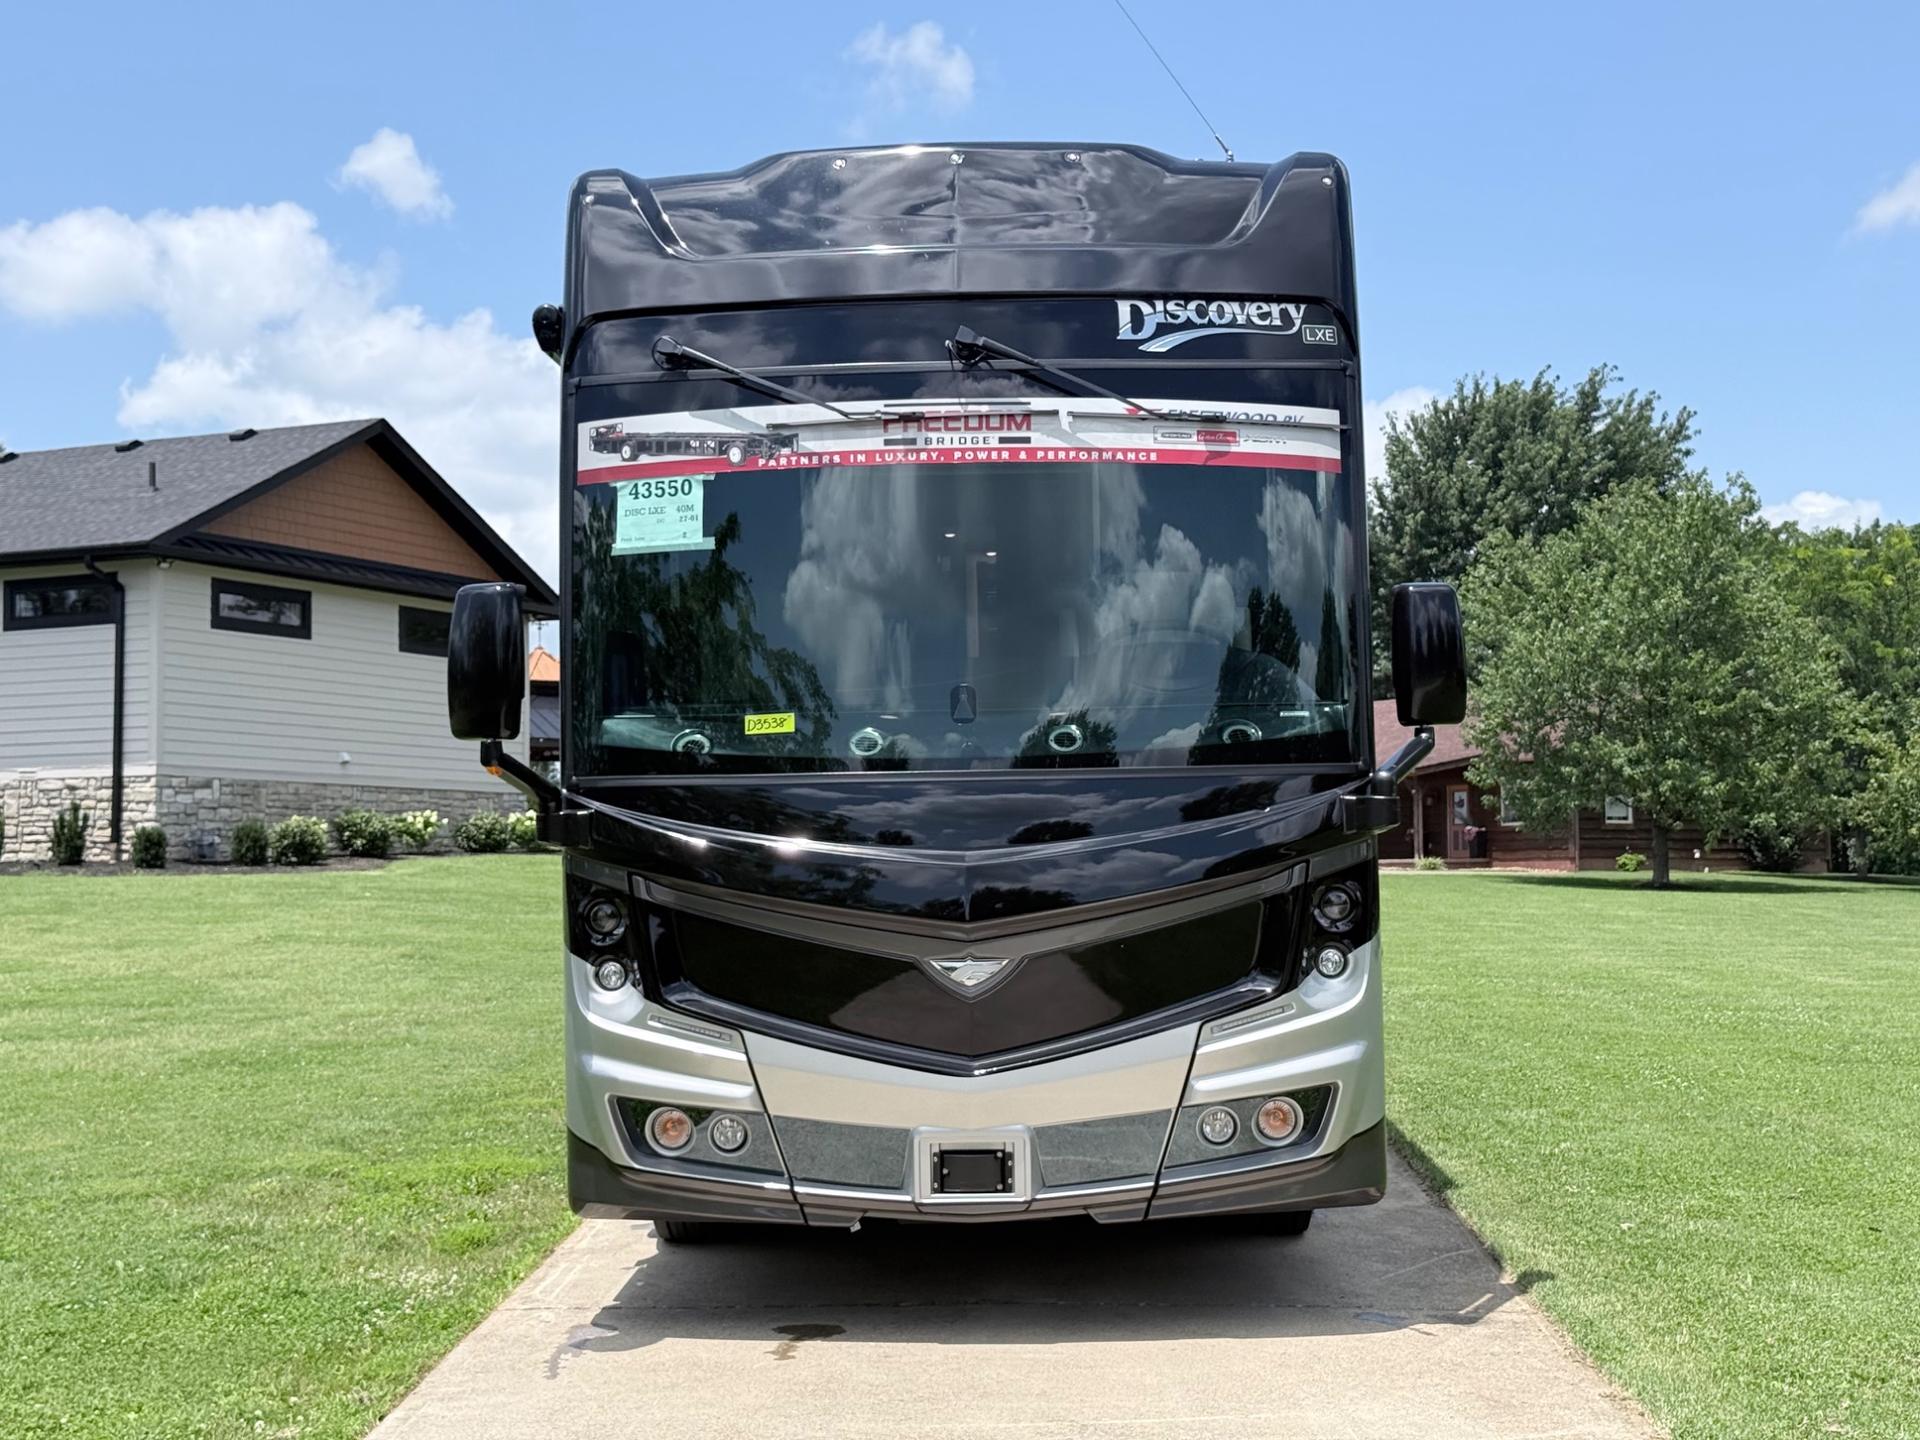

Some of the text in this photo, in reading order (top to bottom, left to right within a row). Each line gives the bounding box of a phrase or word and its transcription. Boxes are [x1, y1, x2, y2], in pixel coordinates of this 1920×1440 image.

[1114, 299, 1308, 340] Discovery
[1305, 328, 1335, 342] LXE
[924, 436, 991, 446] BRIDGE
[757, 450, 1159, 468] PARTNERS IN LUXURY, POWER & PERFORMANCE
[628, 478, 693, 500] 43550
[624, 507, 647, 518] DISC
[647, 506, 667, 515] LXE
